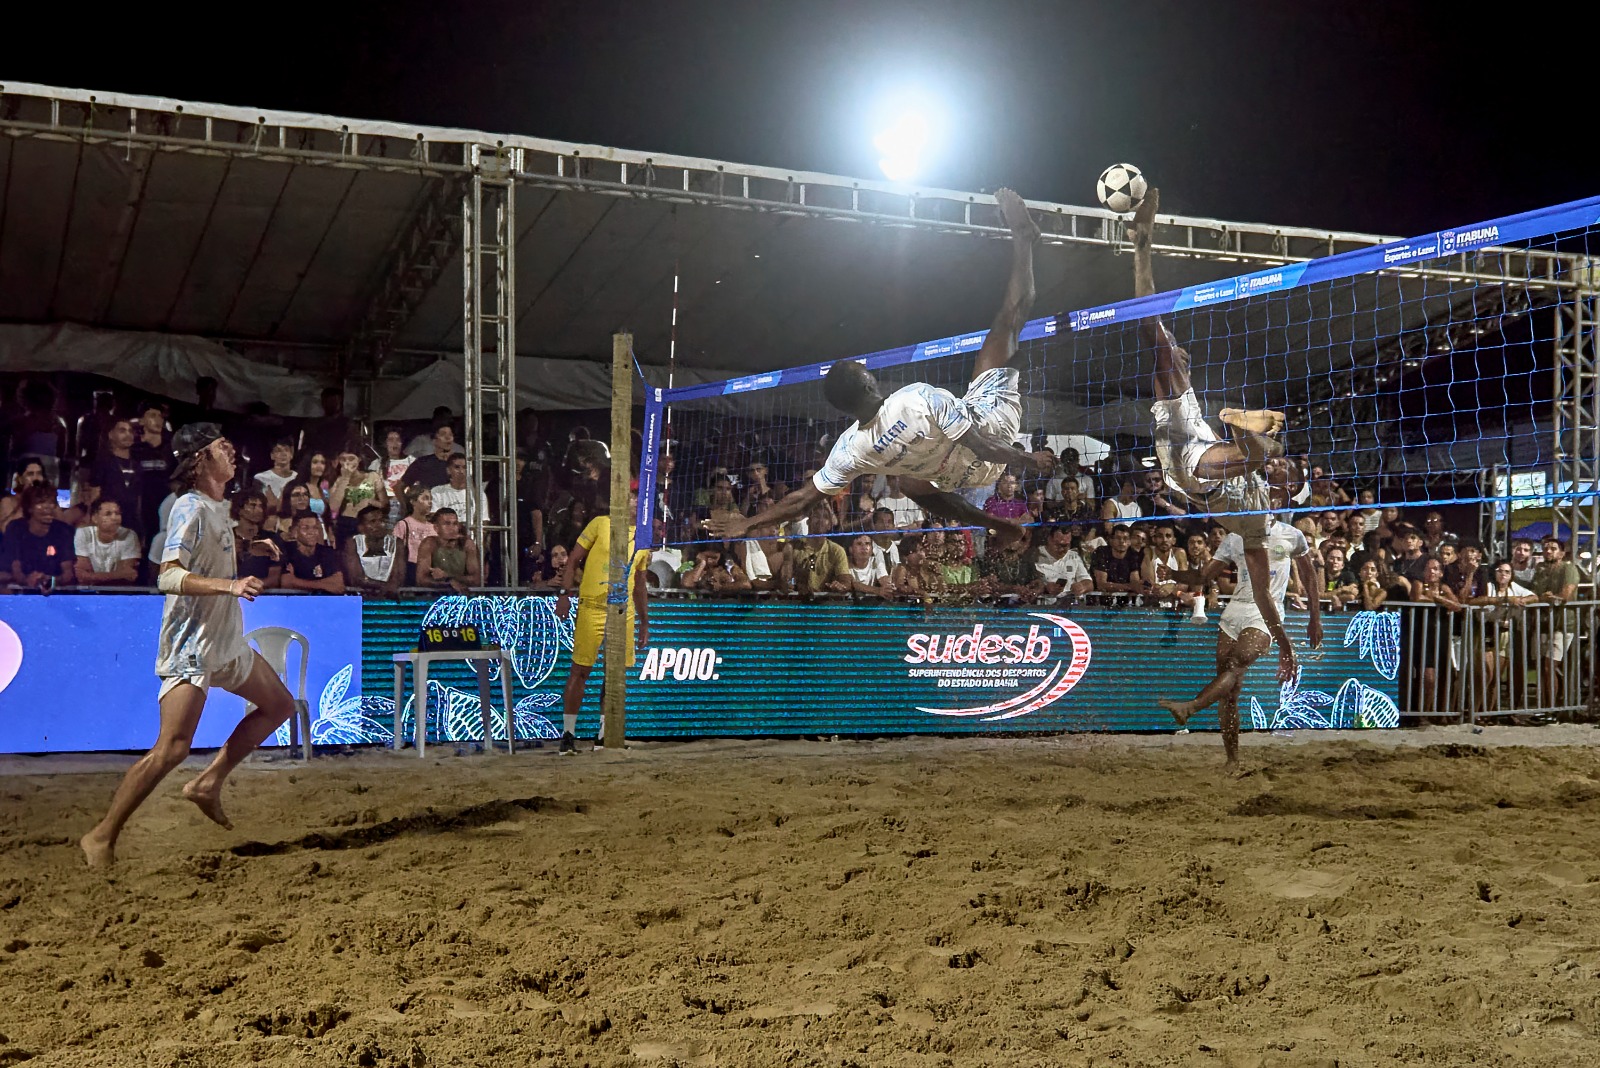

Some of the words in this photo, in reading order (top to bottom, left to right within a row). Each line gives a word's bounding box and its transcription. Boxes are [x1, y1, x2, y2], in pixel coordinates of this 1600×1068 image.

[1456, 226, 1499, 243] ITABUNA
[1384, 250, 1411, 263] Esportes
[1418, 246, 1437, 255] Lazer
[1249, 273, 1283, 288] ITABUNA
[872, 419, 908, 454] ATLETA
[426, 629, 443, 643] 16
[452, 629, 458, 637] 0
[460, 628, 477, 641] 16
[904, 624, 1051, 664] sudesb
[639, 648, 723, 680] APOIO:
[908, 668, 984, 678] SUPERINTENDÊNCIA
[985, 669, 1001, 678] DOS
[938, 679, 950, 687] DO
[951, 679, 980, 687] ESTADO
[982, 679, 993, 687] DA
